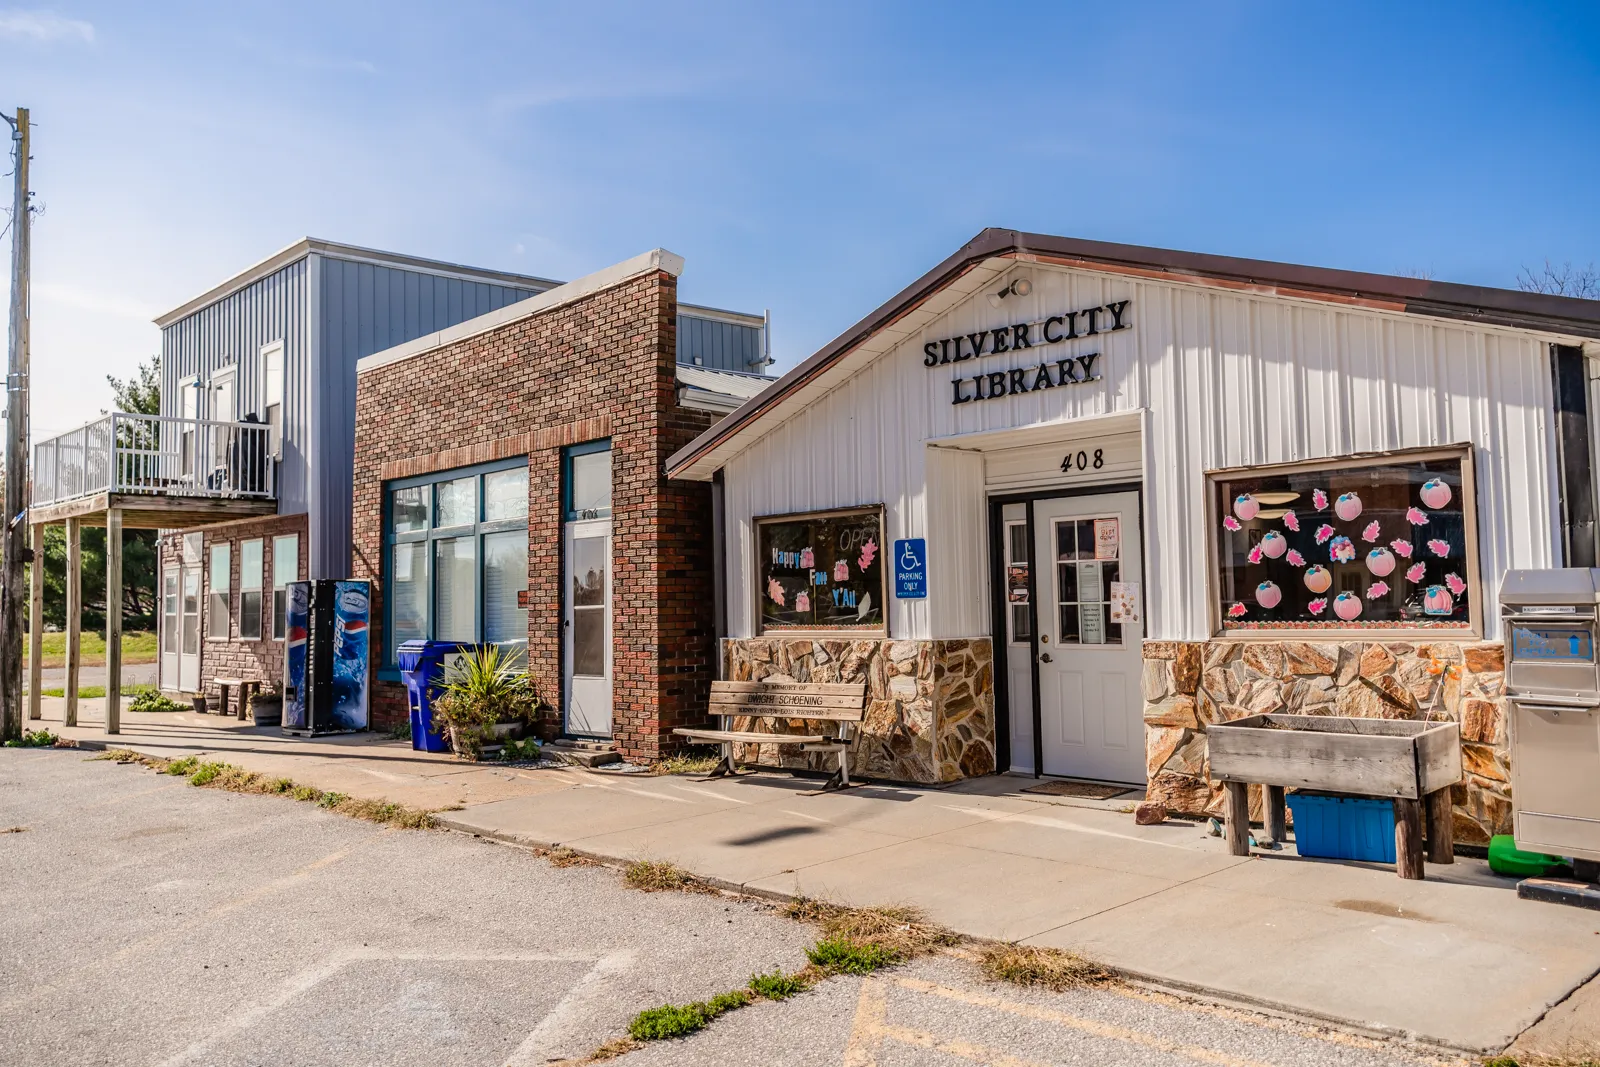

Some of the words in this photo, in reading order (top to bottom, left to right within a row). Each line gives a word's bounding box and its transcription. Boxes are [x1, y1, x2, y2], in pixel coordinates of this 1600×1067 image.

[923, 322, 1032, 368] SILVER
[1043, 300, 1130, 343] CITY
[951, 353, 1100, 406] LIBRARY
[1060, 448, 1104, 473] 408
[772, 547, 800, 569] Happy
[898, 571, 923, 581] PARKING
[903, 582, 918, 591] ONLY
[334, 614, 347, 656] PEPSI
[778, 695, 823, 705] SCHOENING
